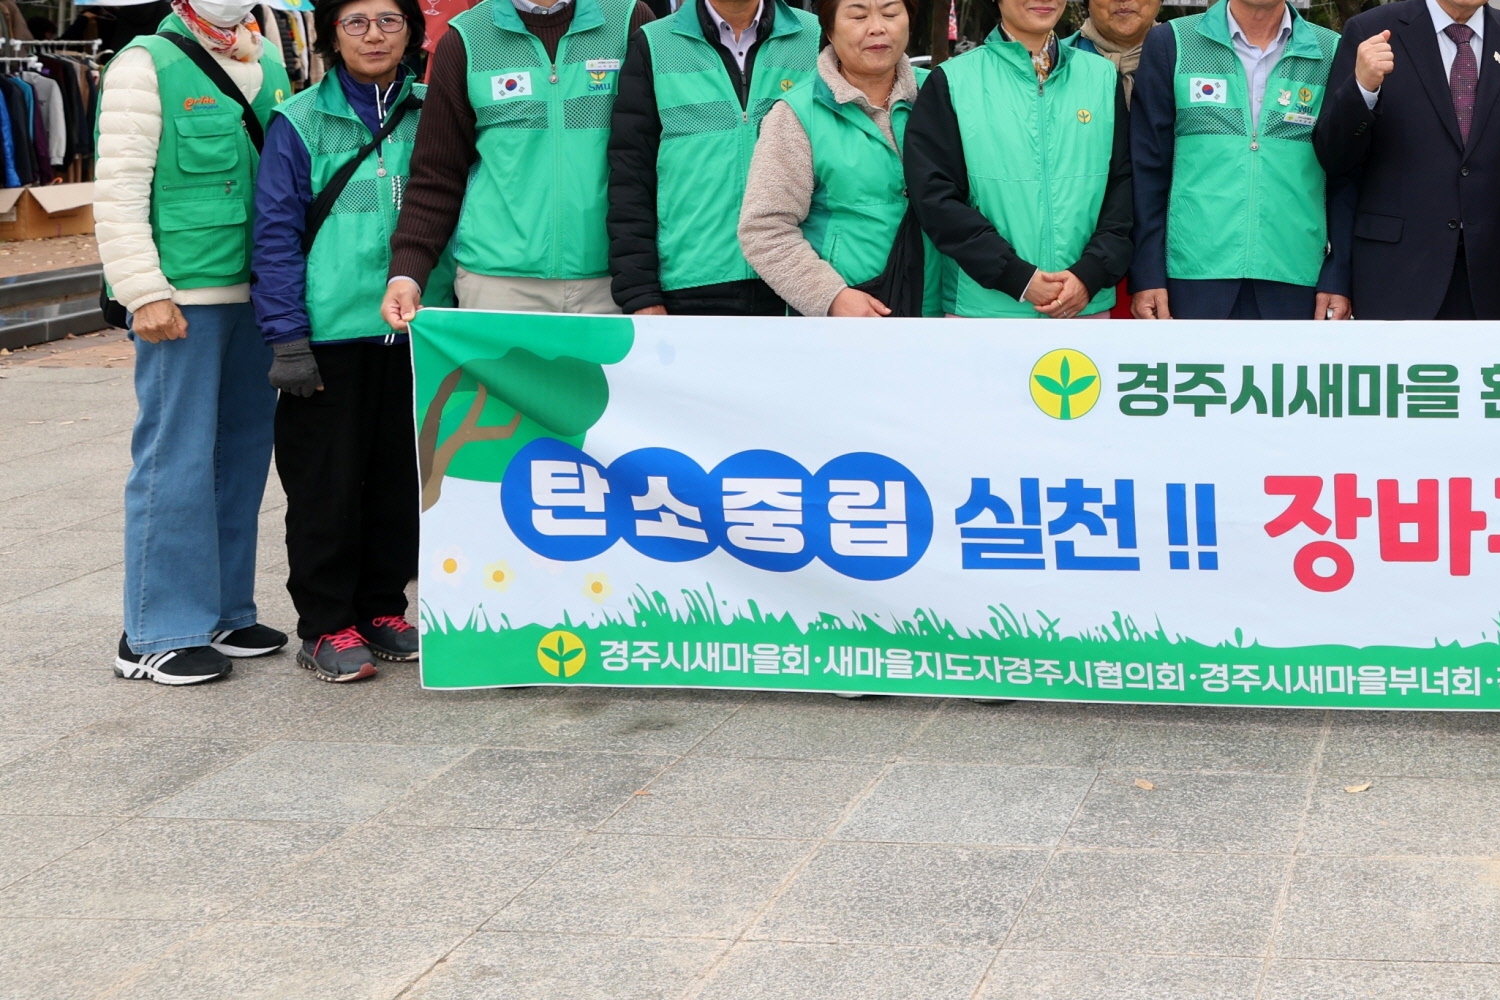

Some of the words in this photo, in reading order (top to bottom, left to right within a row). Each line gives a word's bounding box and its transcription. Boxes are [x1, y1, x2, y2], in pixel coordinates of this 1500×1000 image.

[588, 82, 611, 91] SMU
[1117, 363, 1460, 418] 경주시새마을
[530, 460, 908, 557] 탄소중립
[955, 477, 1140, 571] 실천
